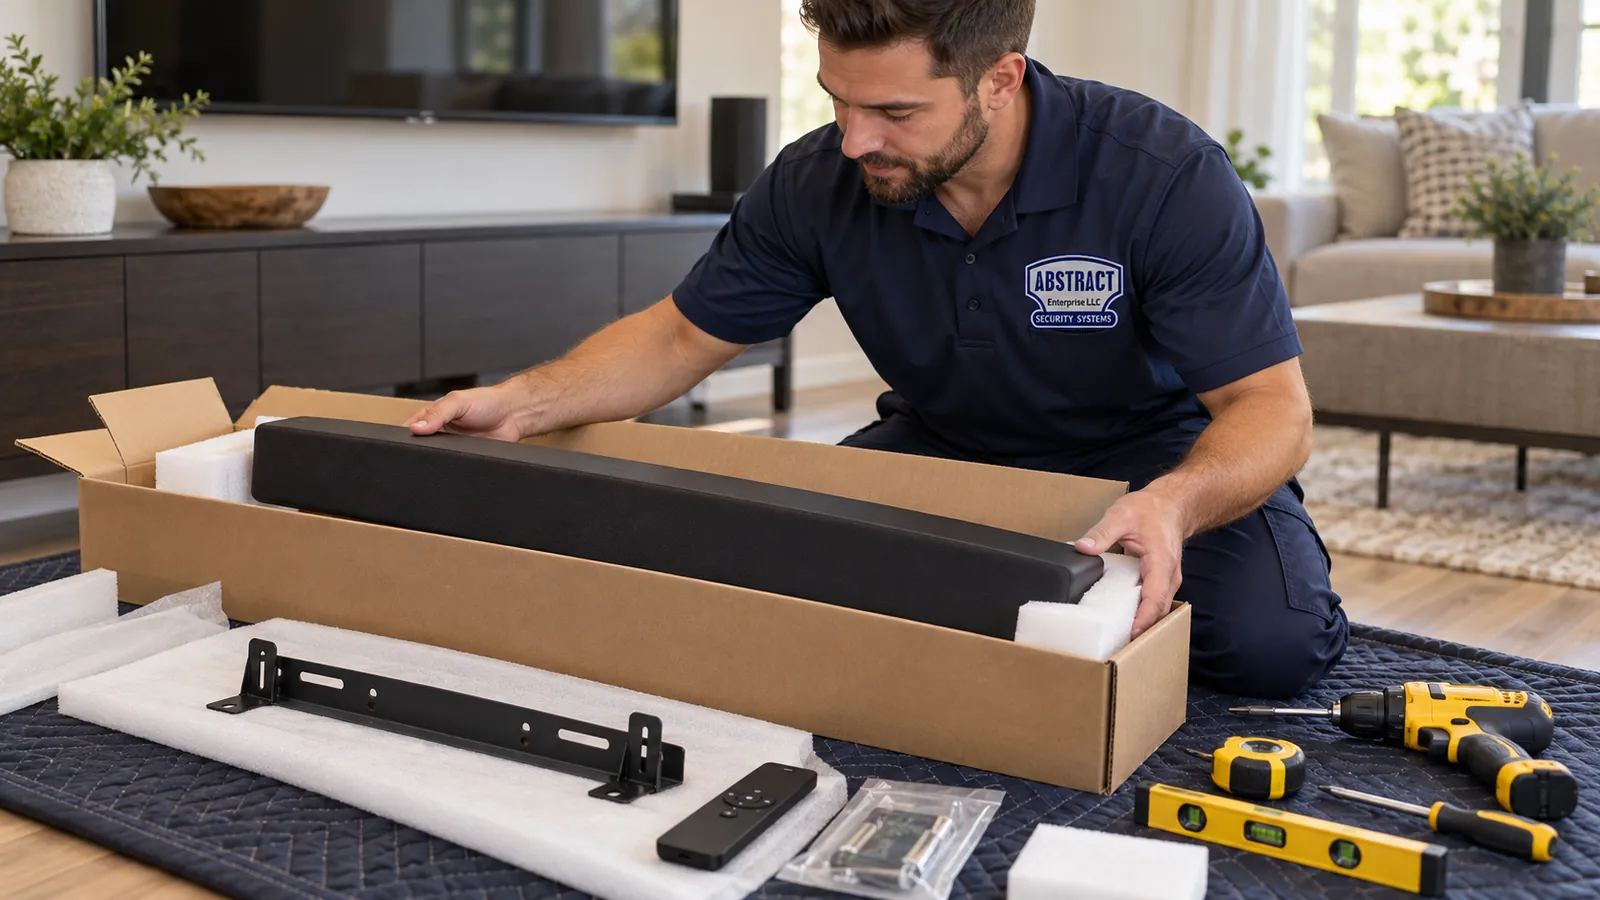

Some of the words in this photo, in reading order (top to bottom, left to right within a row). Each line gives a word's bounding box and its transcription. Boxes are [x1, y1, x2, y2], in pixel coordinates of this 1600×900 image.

[1034, 270, 1115, 292] ABSTRACT
[1047, 298, 1085, 308] Enterprise
[1086, 298, 1101, 306] LLC
[1035, 314, 1074, 323] SECURITY
[1076, 314, 1112, 323] SYSTEMS
